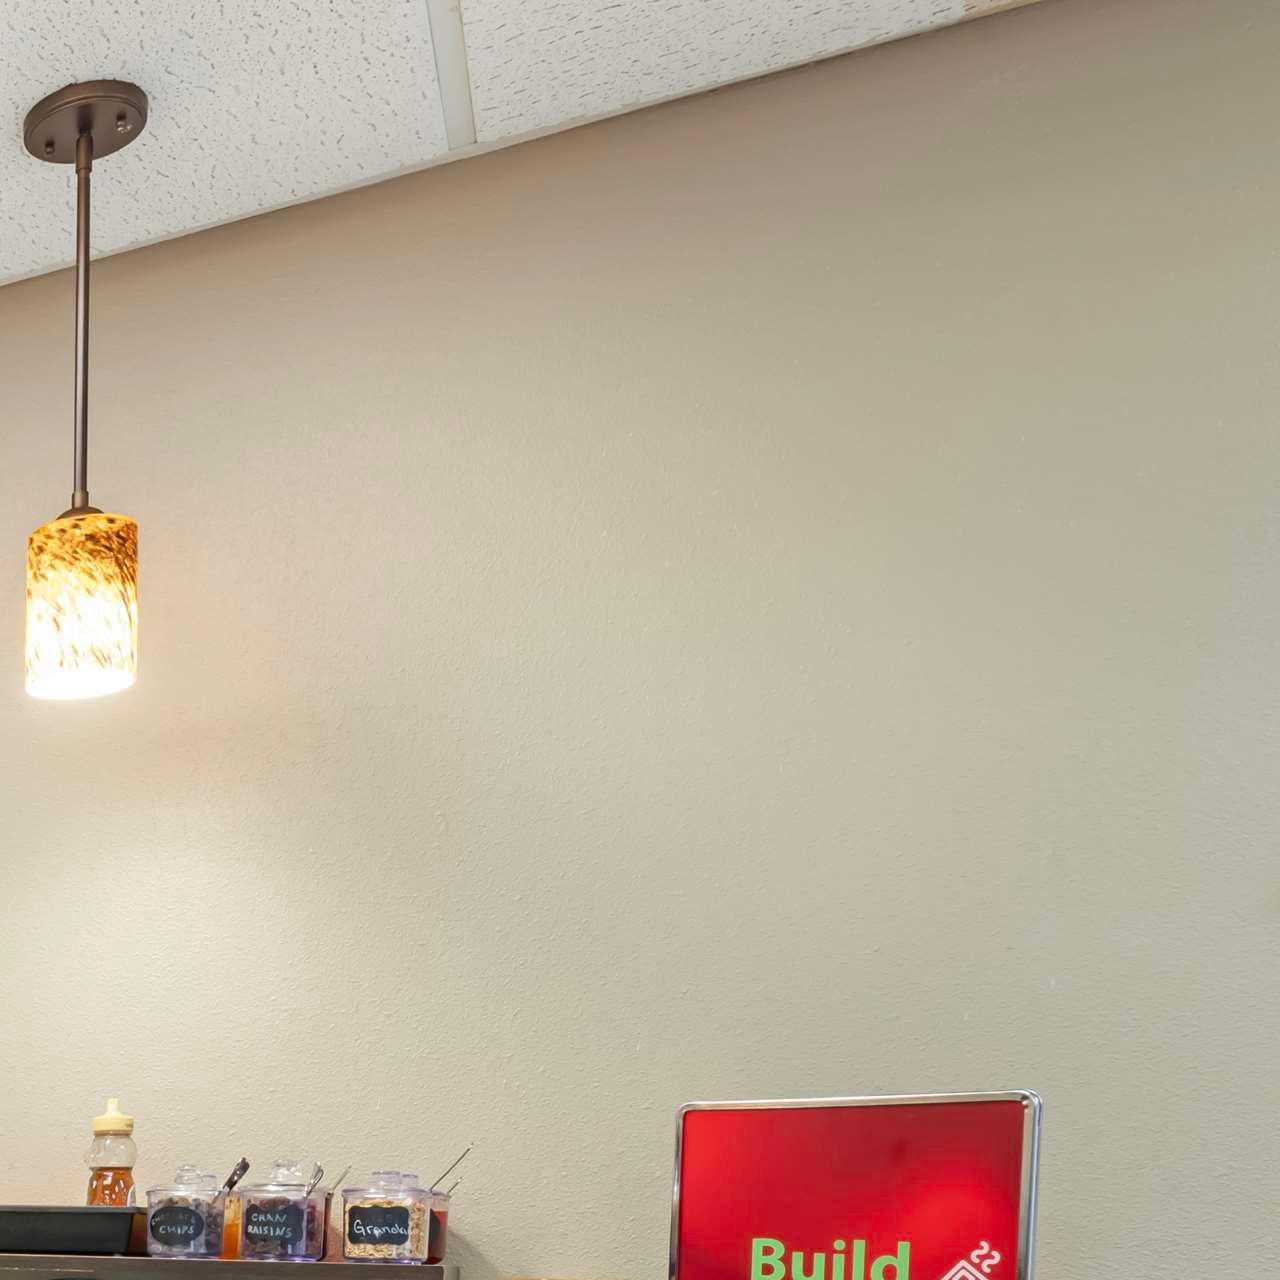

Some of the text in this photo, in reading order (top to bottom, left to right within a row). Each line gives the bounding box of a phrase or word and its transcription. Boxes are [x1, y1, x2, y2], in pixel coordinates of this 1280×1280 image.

[251, 1213, 287, 1223] CRAN
[159, 1225, 194, 1235] CHIPS
[248, 1225, 292, 1238] RAISINS
